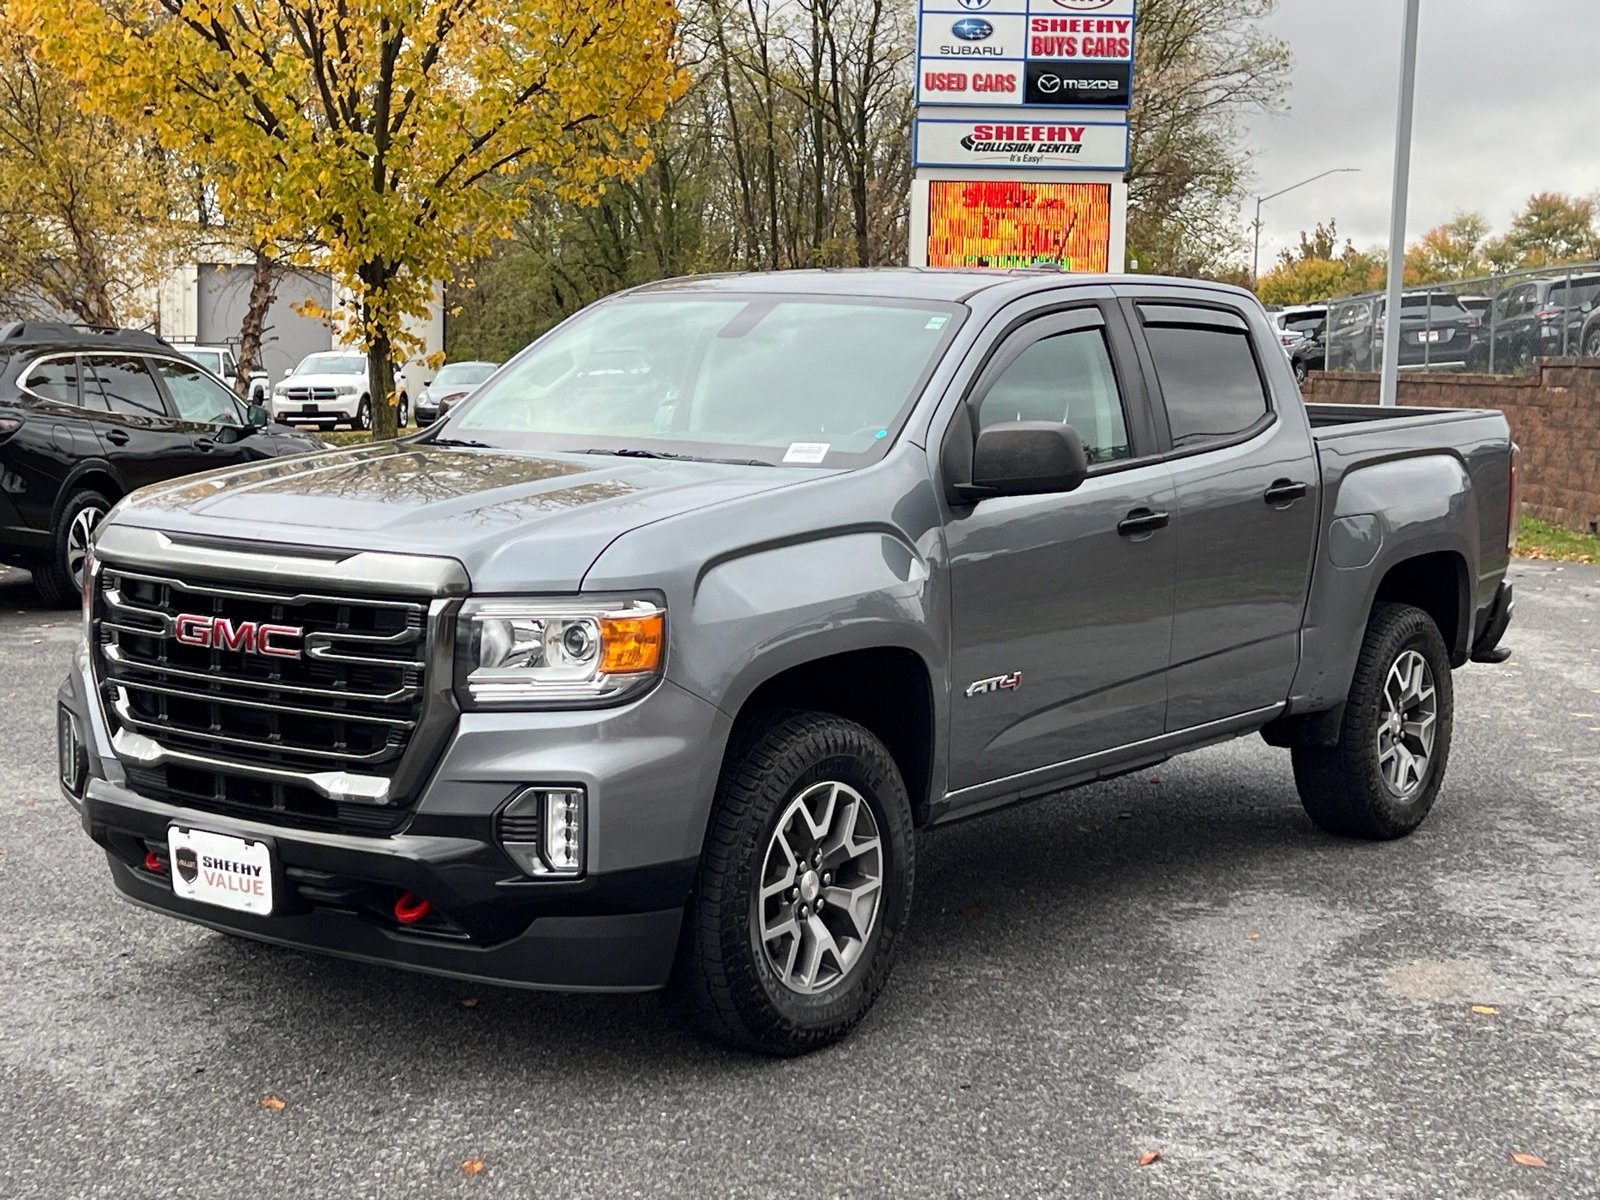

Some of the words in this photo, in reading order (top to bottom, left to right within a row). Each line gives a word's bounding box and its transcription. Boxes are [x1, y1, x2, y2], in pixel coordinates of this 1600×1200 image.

[1031, 19, 1130, 33] SHEEHY
[940, 45, 1003, 55] SUBARU
[1031, 36, 1077, 56] BUYS
[1082, 37, 1129, 58] CARS
[925, 72, 967, 92] USED
[972, 73, 1016, 93] CARS
[1063, 79, 1119, 90] mazda
[973, 125, 1085, 142] SHEEHY
[973, 142, 1036, 153] COLLISION
[1037, 143, 1083, 154] CENTER
[1009, 154, 1022, 163] It's
[1023, 154, 1044, 164] Easy!
[175, 613, 304, 660] GMC
[965, 670, 1022, 697] AT4
[202, 855, 262, 877] SHEEHY
[203, 870, 265, 896] VALUE
